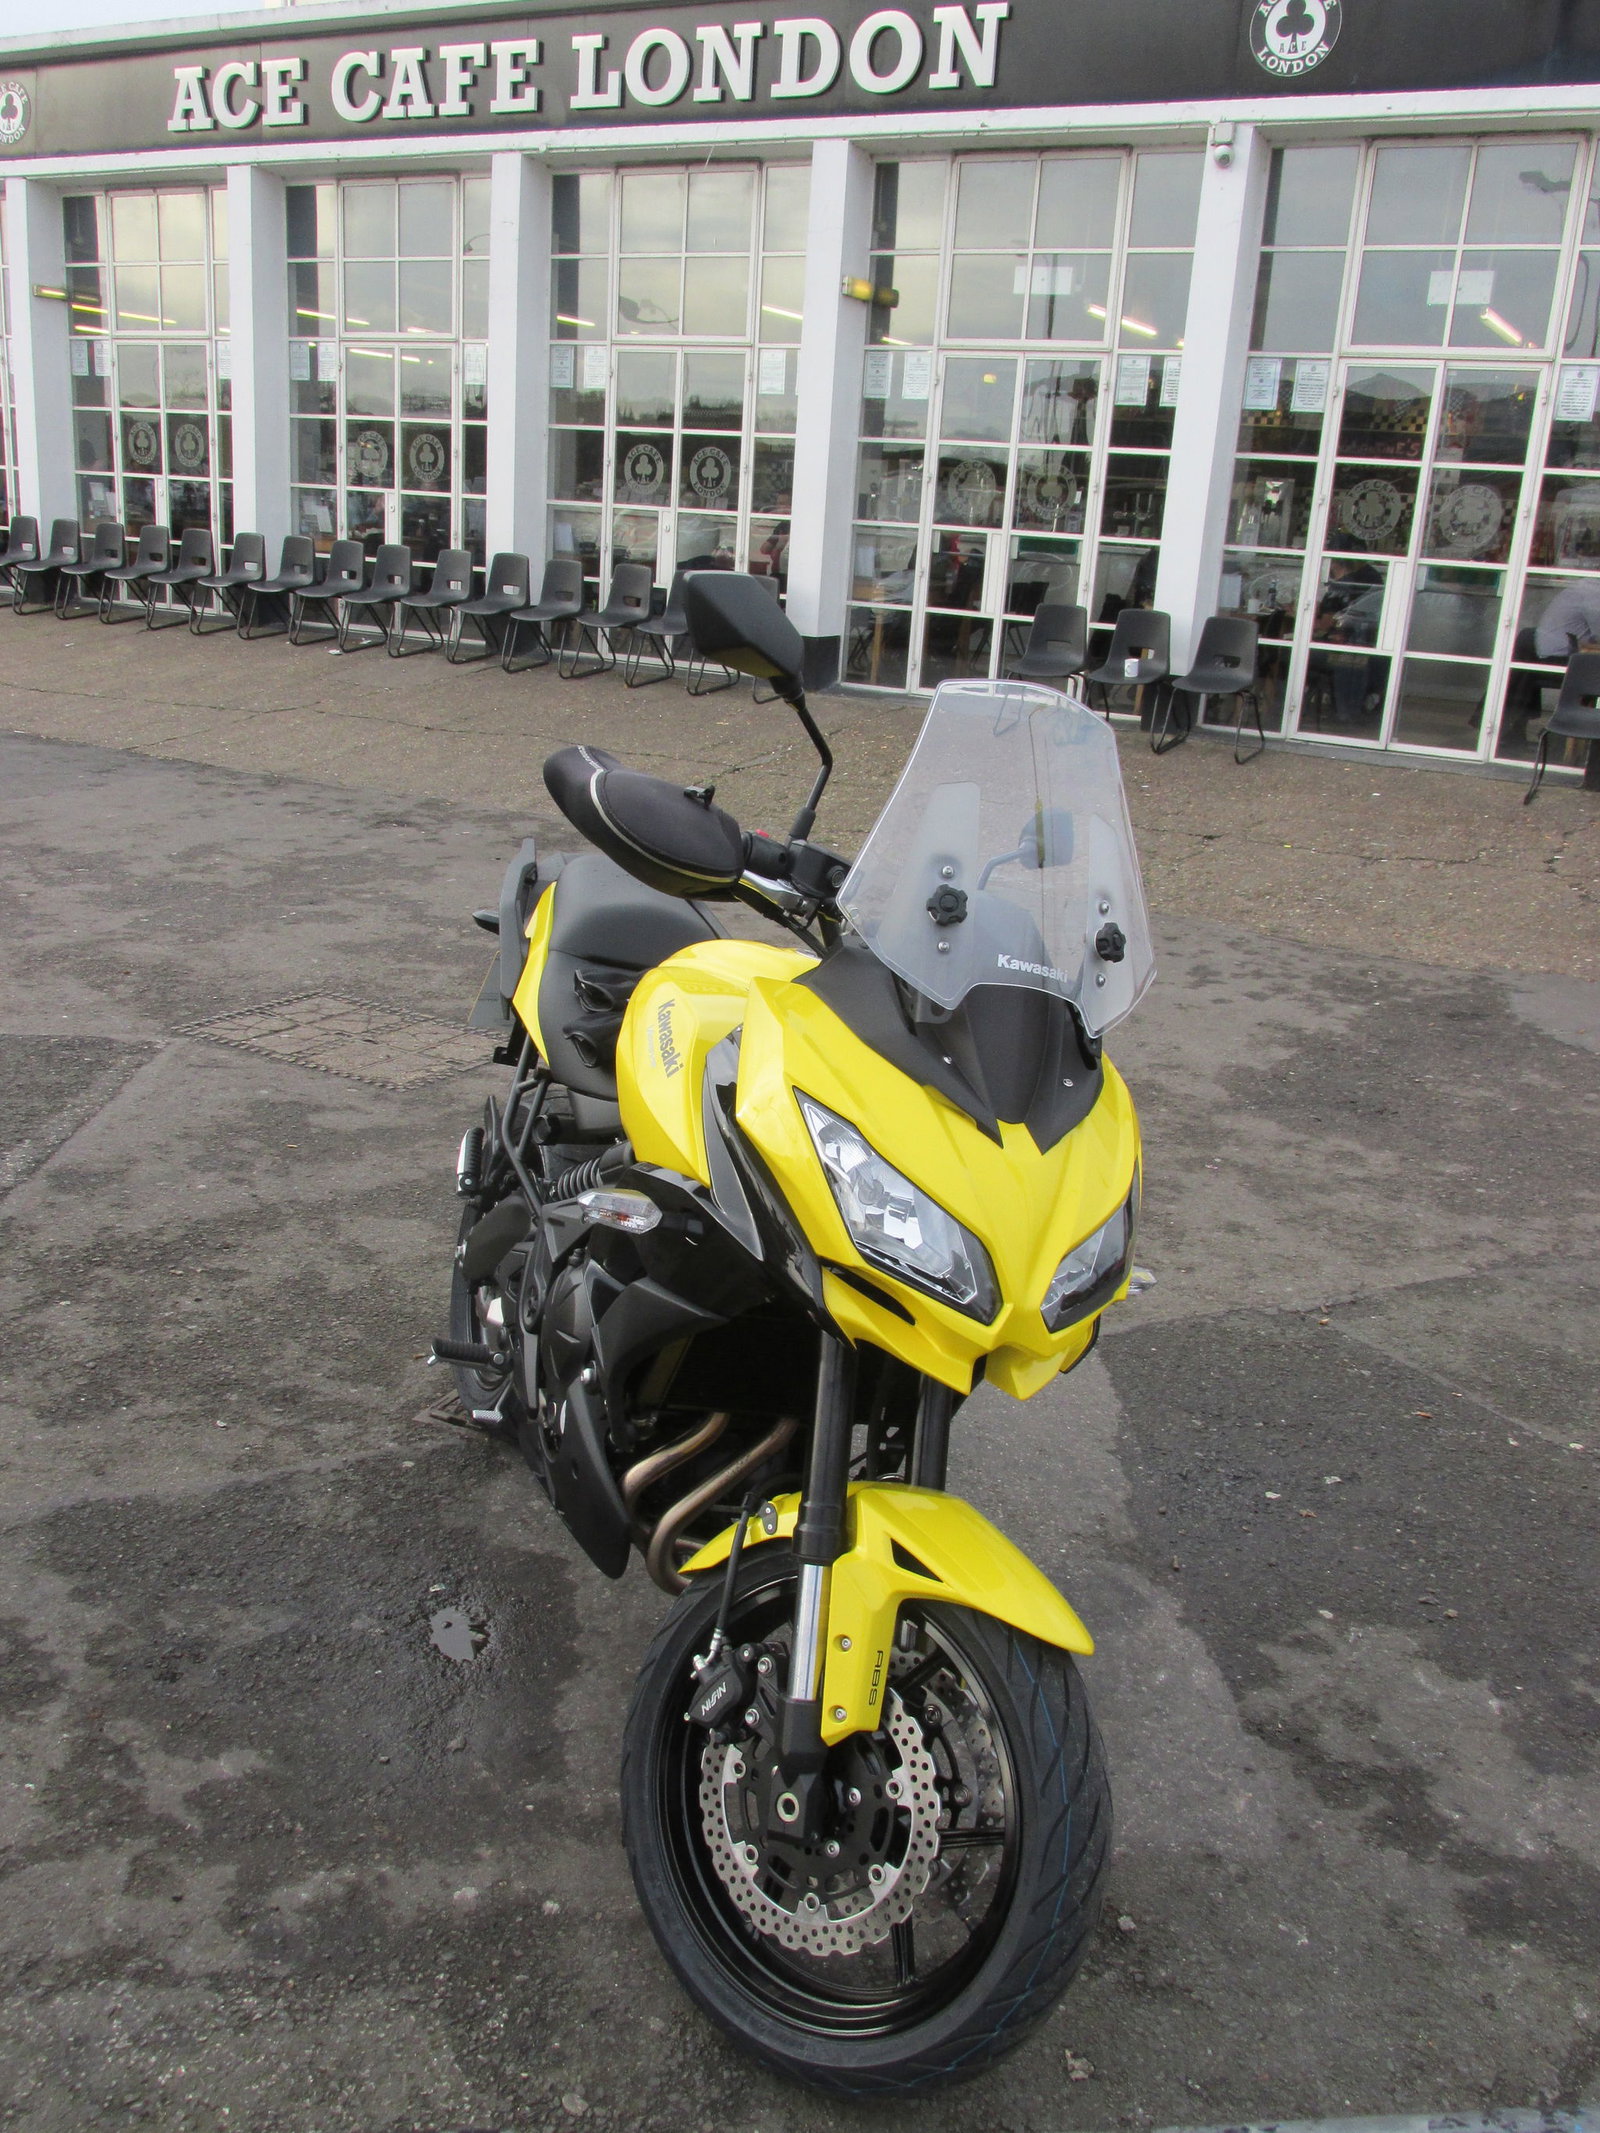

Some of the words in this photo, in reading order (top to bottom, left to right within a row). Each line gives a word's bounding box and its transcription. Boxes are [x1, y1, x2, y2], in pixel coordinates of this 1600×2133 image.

[168, 57, 306, 132] ACE
[331, 39, 541, 123] CAFE
[570, 2, 1010, 110] LONDON
[1257, 40, 1329, 74] LONDON
[997, 953, 1068, 983] Kawasaki
[658, 998, 684, 1078] Kawasaki
[868, 1650, 884, 1706] ABS
